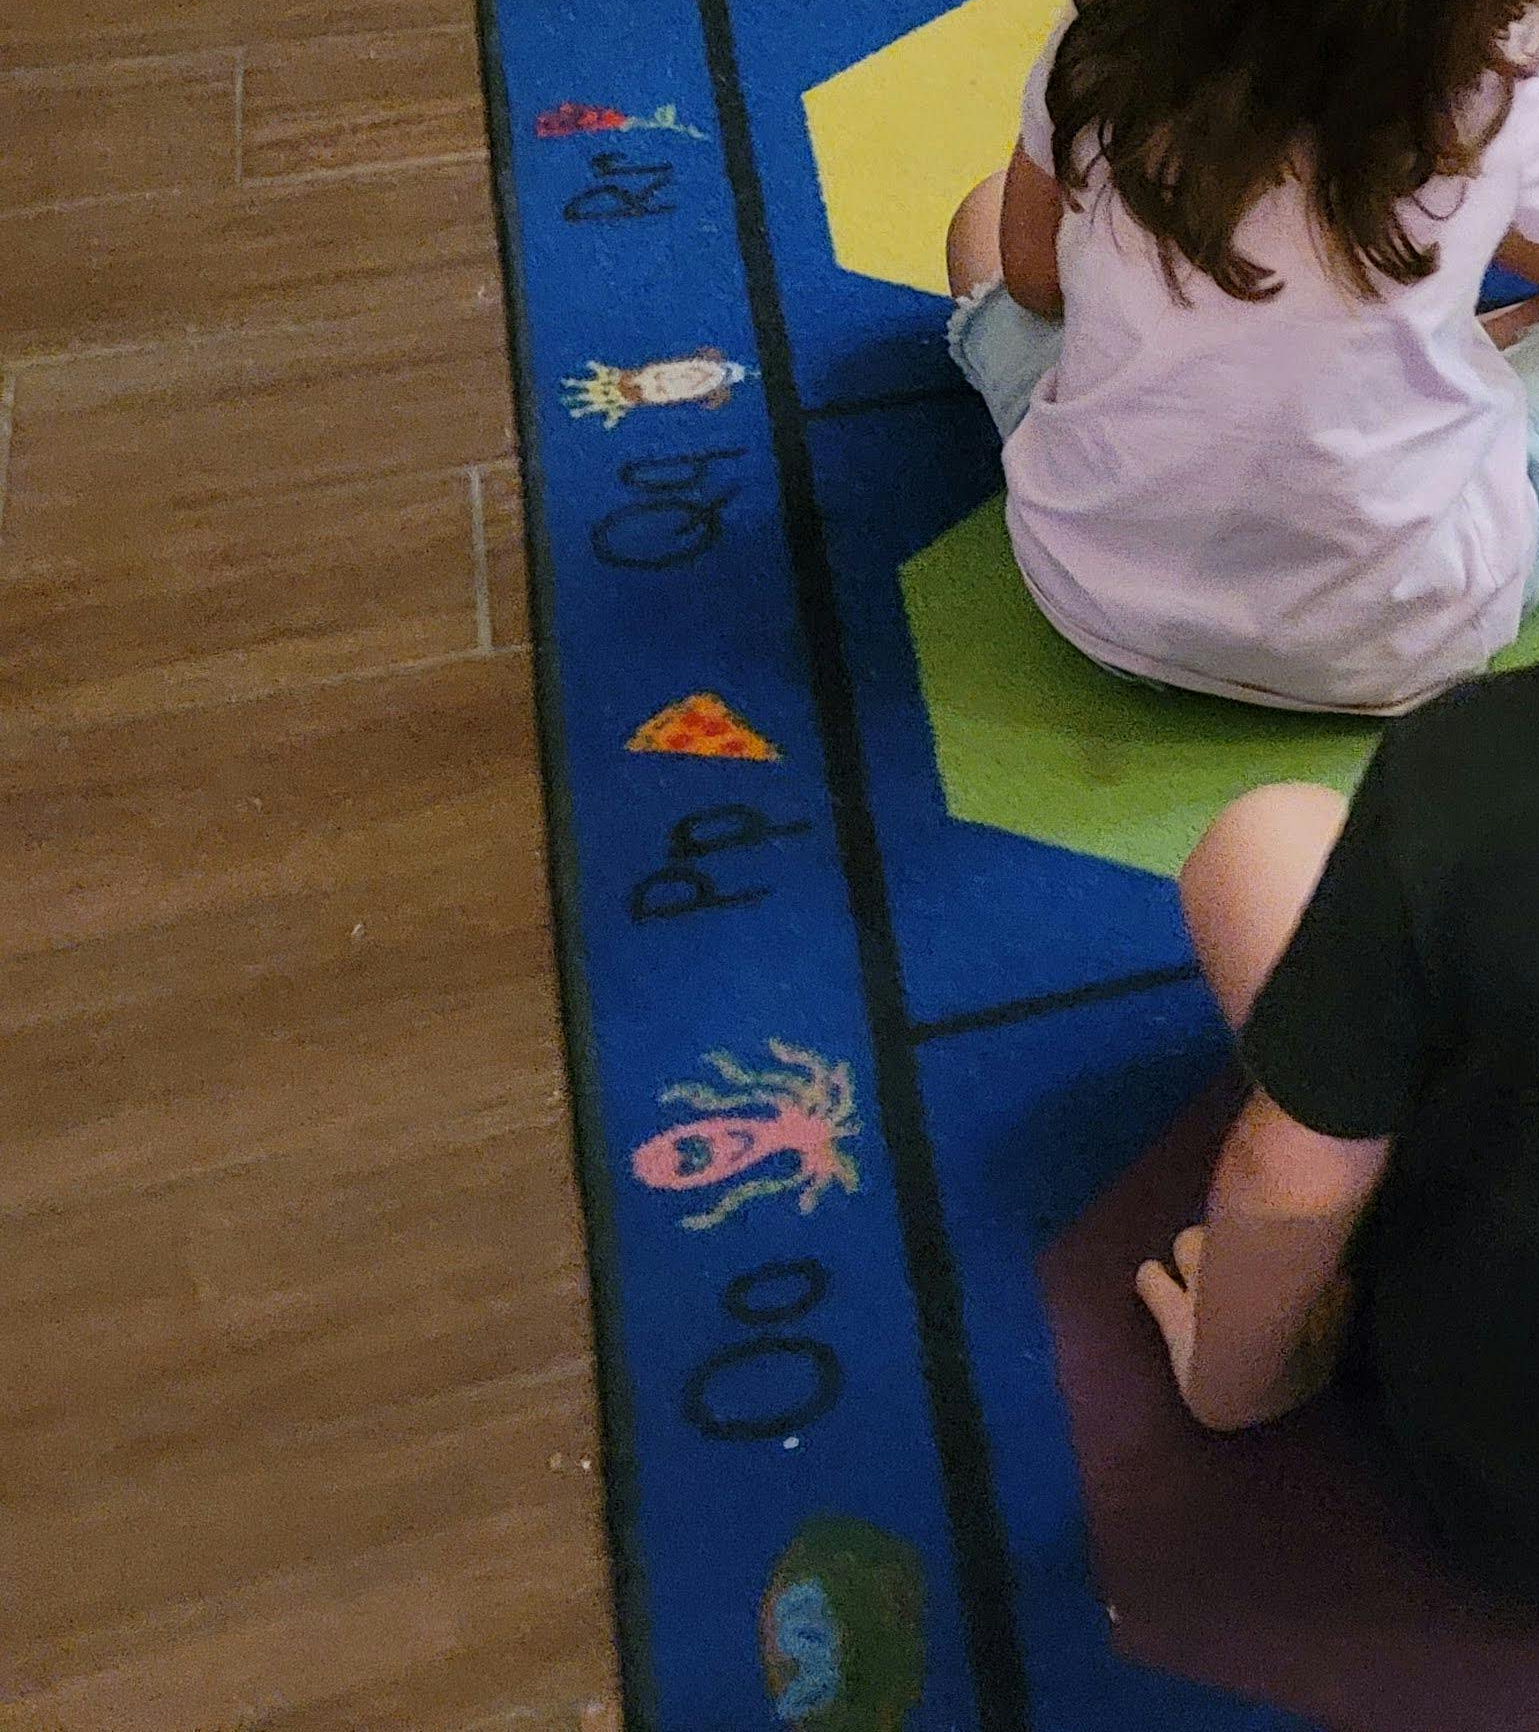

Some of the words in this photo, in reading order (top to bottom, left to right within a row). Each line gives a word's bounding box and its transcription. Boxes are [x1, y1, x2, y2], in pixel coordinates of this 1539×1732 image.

[562, 152, 676, 225] Rr
[590, 445, 749, 569] Qq
[630, 803, 813, 926] Pp
[680, 1258, 845, 1443] Oo
